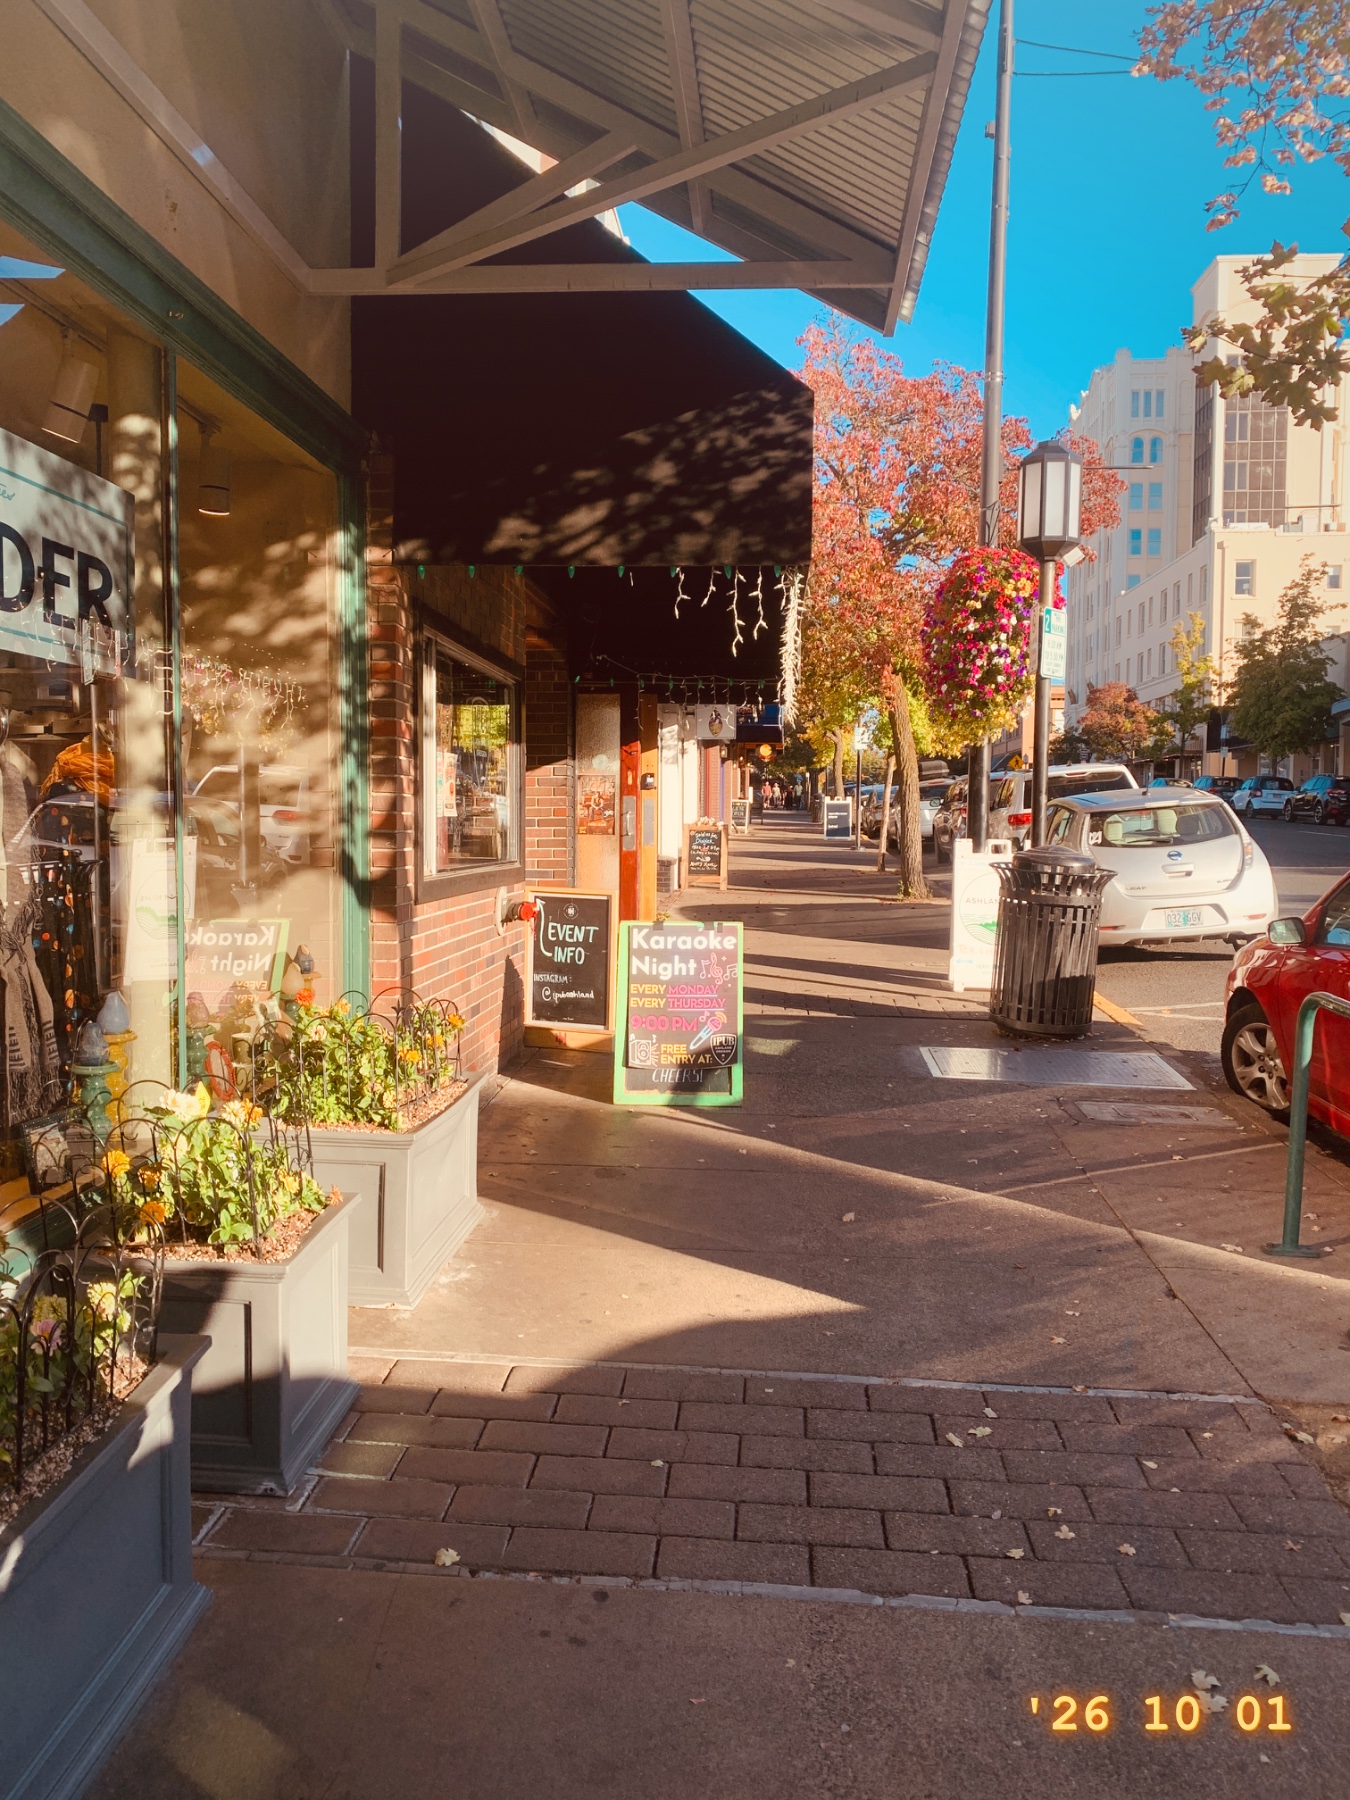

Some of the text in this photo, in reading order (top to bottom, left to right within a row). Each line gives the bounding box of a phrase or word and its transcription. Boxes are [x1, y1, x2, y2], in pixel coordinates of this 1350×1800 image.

[965, 897, 999, 905] ASHLAN
[548, 922, 599, 943] EVENT
[554, 946, 585, 965] INFO
[631, 955, 697, 981] Night
[630, 983, 719, 995] EVERY MONDAY
[630, 997, 726, 1009] EVERY THURSDAY
[630, 1014, 699, 1032] 9:00 PM
[712, 1036, 735, 1046] IPUB
[660, 1043, 688, 1054] FREE
[660, 1053, 713, 1065] ENTRY AT:
